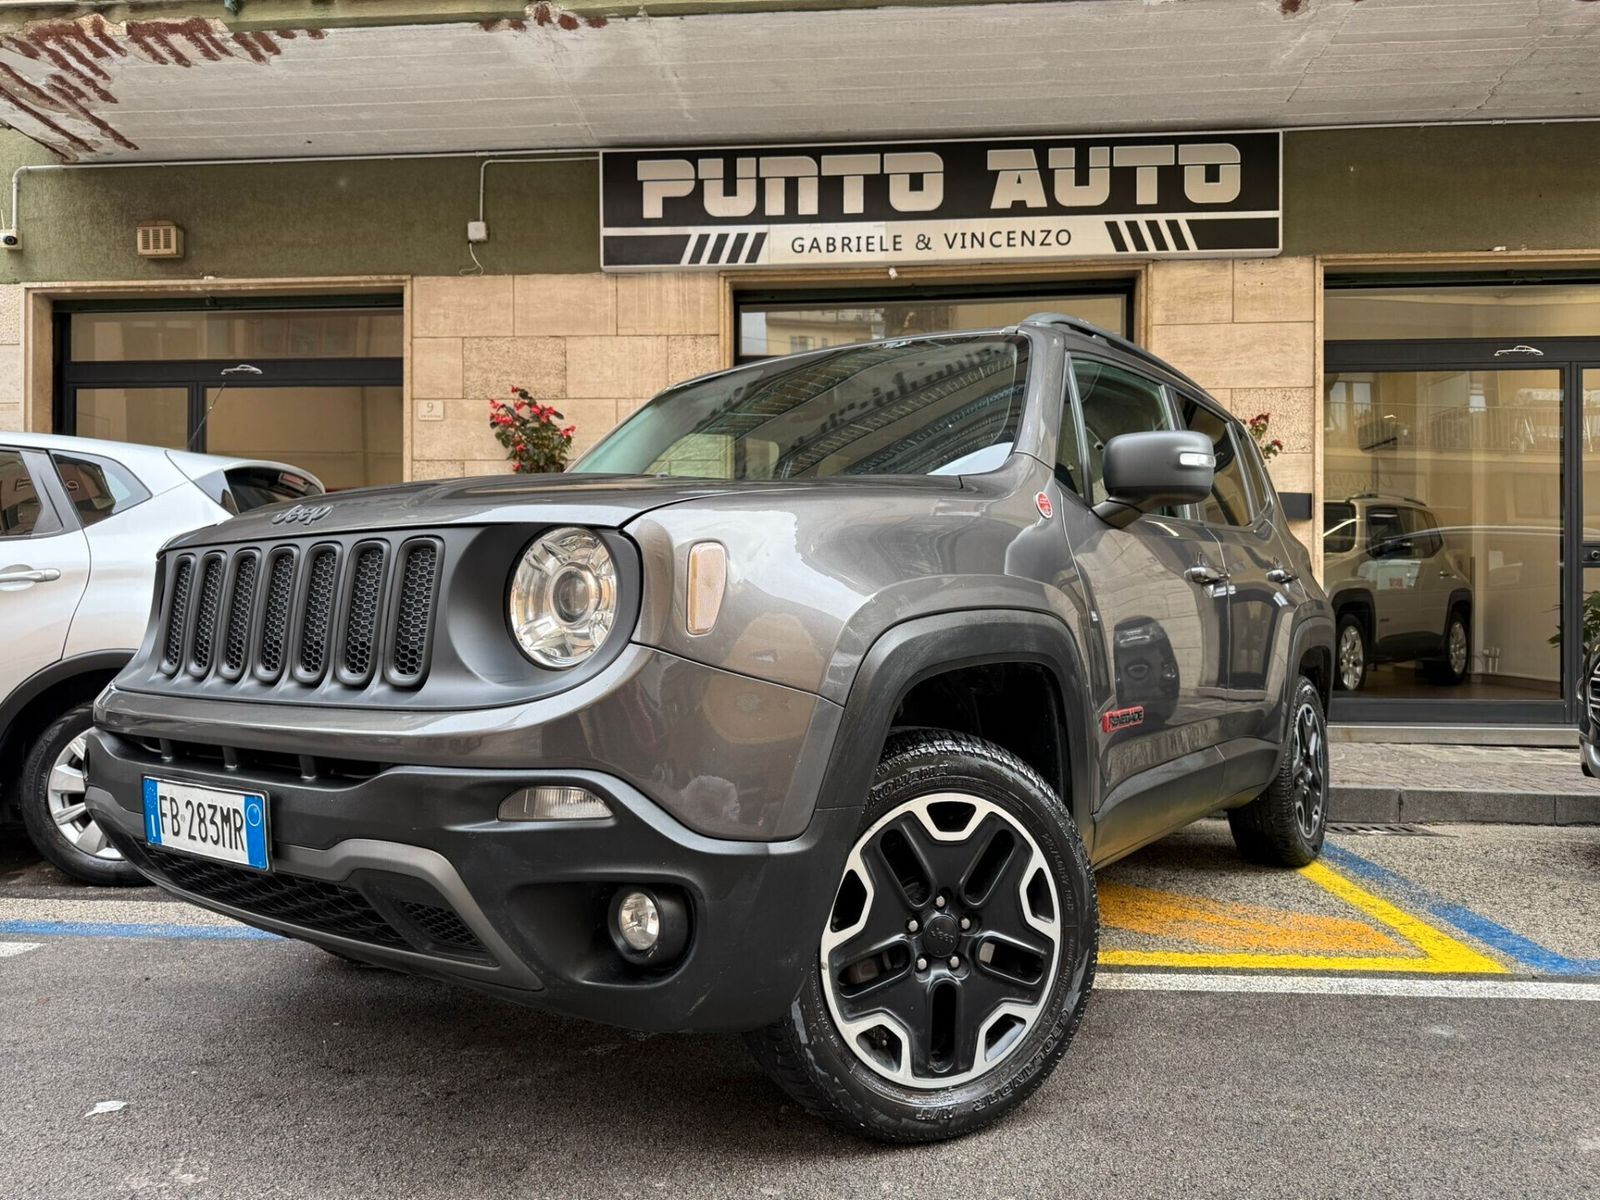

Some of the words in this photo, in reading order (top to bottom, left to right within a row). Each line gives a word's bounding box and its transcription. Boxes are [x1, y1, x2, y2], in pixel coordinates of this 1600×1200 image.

[636, 151, 945, 219] PUNTO
[986, 142, 1241, 209] AUTO
[791, 233, 903, 254] GABRIELE
[915, 234, 932, 251] &
[943, 229, 1073, 250] VINCENZO
[426, 401, 434, 413] 9
[271, 504, 334, 526] Jeep
[159, 795, 181, 837] FB
[185, 800, 245, 851] 283MR
